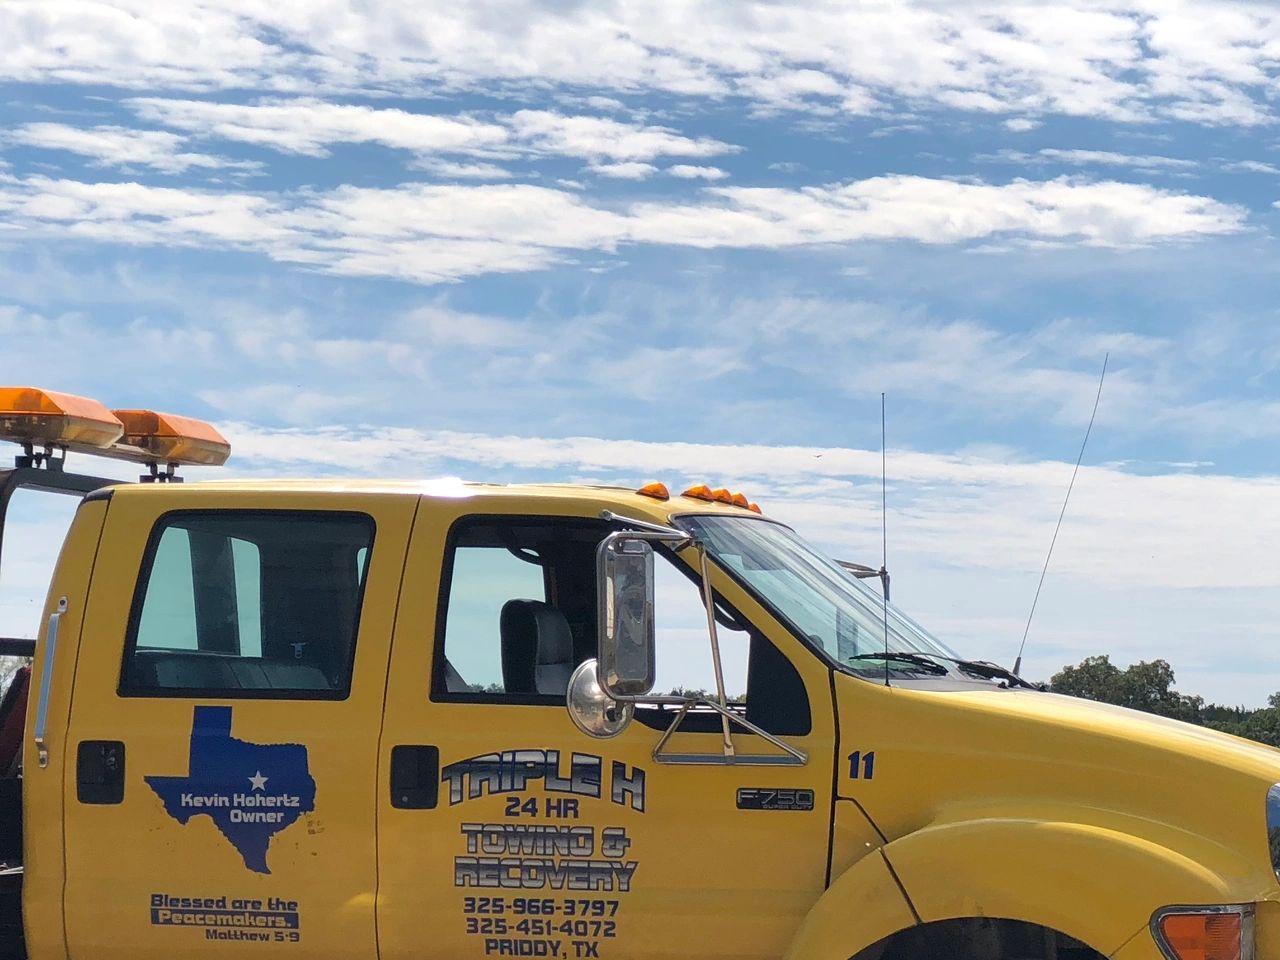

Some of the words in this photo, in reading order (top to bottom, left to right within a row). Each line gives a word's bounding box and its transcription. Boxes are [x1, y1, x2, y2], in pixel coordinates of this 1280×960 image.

[848, 750, 875, 780] 11
[441, 749, 602, 806] TRIPLE
[611, 760, 646, 813] H
[181, 793, 230, 807] Kevin
[233, 793, 300, 807] Hohertz
[505, 796, 538, 817] 24
[545, 798, 579, 818] HR
[230, 809, 285, 823] Owner
[460, 823, 594, 857] TOWING
[601, 827, 631, 858] &
[454, 856, 639, 892] RECOVERY
[151, 894, 227, 909] Blessed
[232, 899, 262, 910] are
[267, 897, 298, 911] the
[463, 897, 620, 917] 325-966-3797
[158, 910, 292, 927] Peacemakers.
[466, 917, 617, 937] 325-451-4072
[205, 929, 270, 941] Matthew
[485, 938, 567, 960] PRIDDY,
[571, 941, 599, 958] TX
